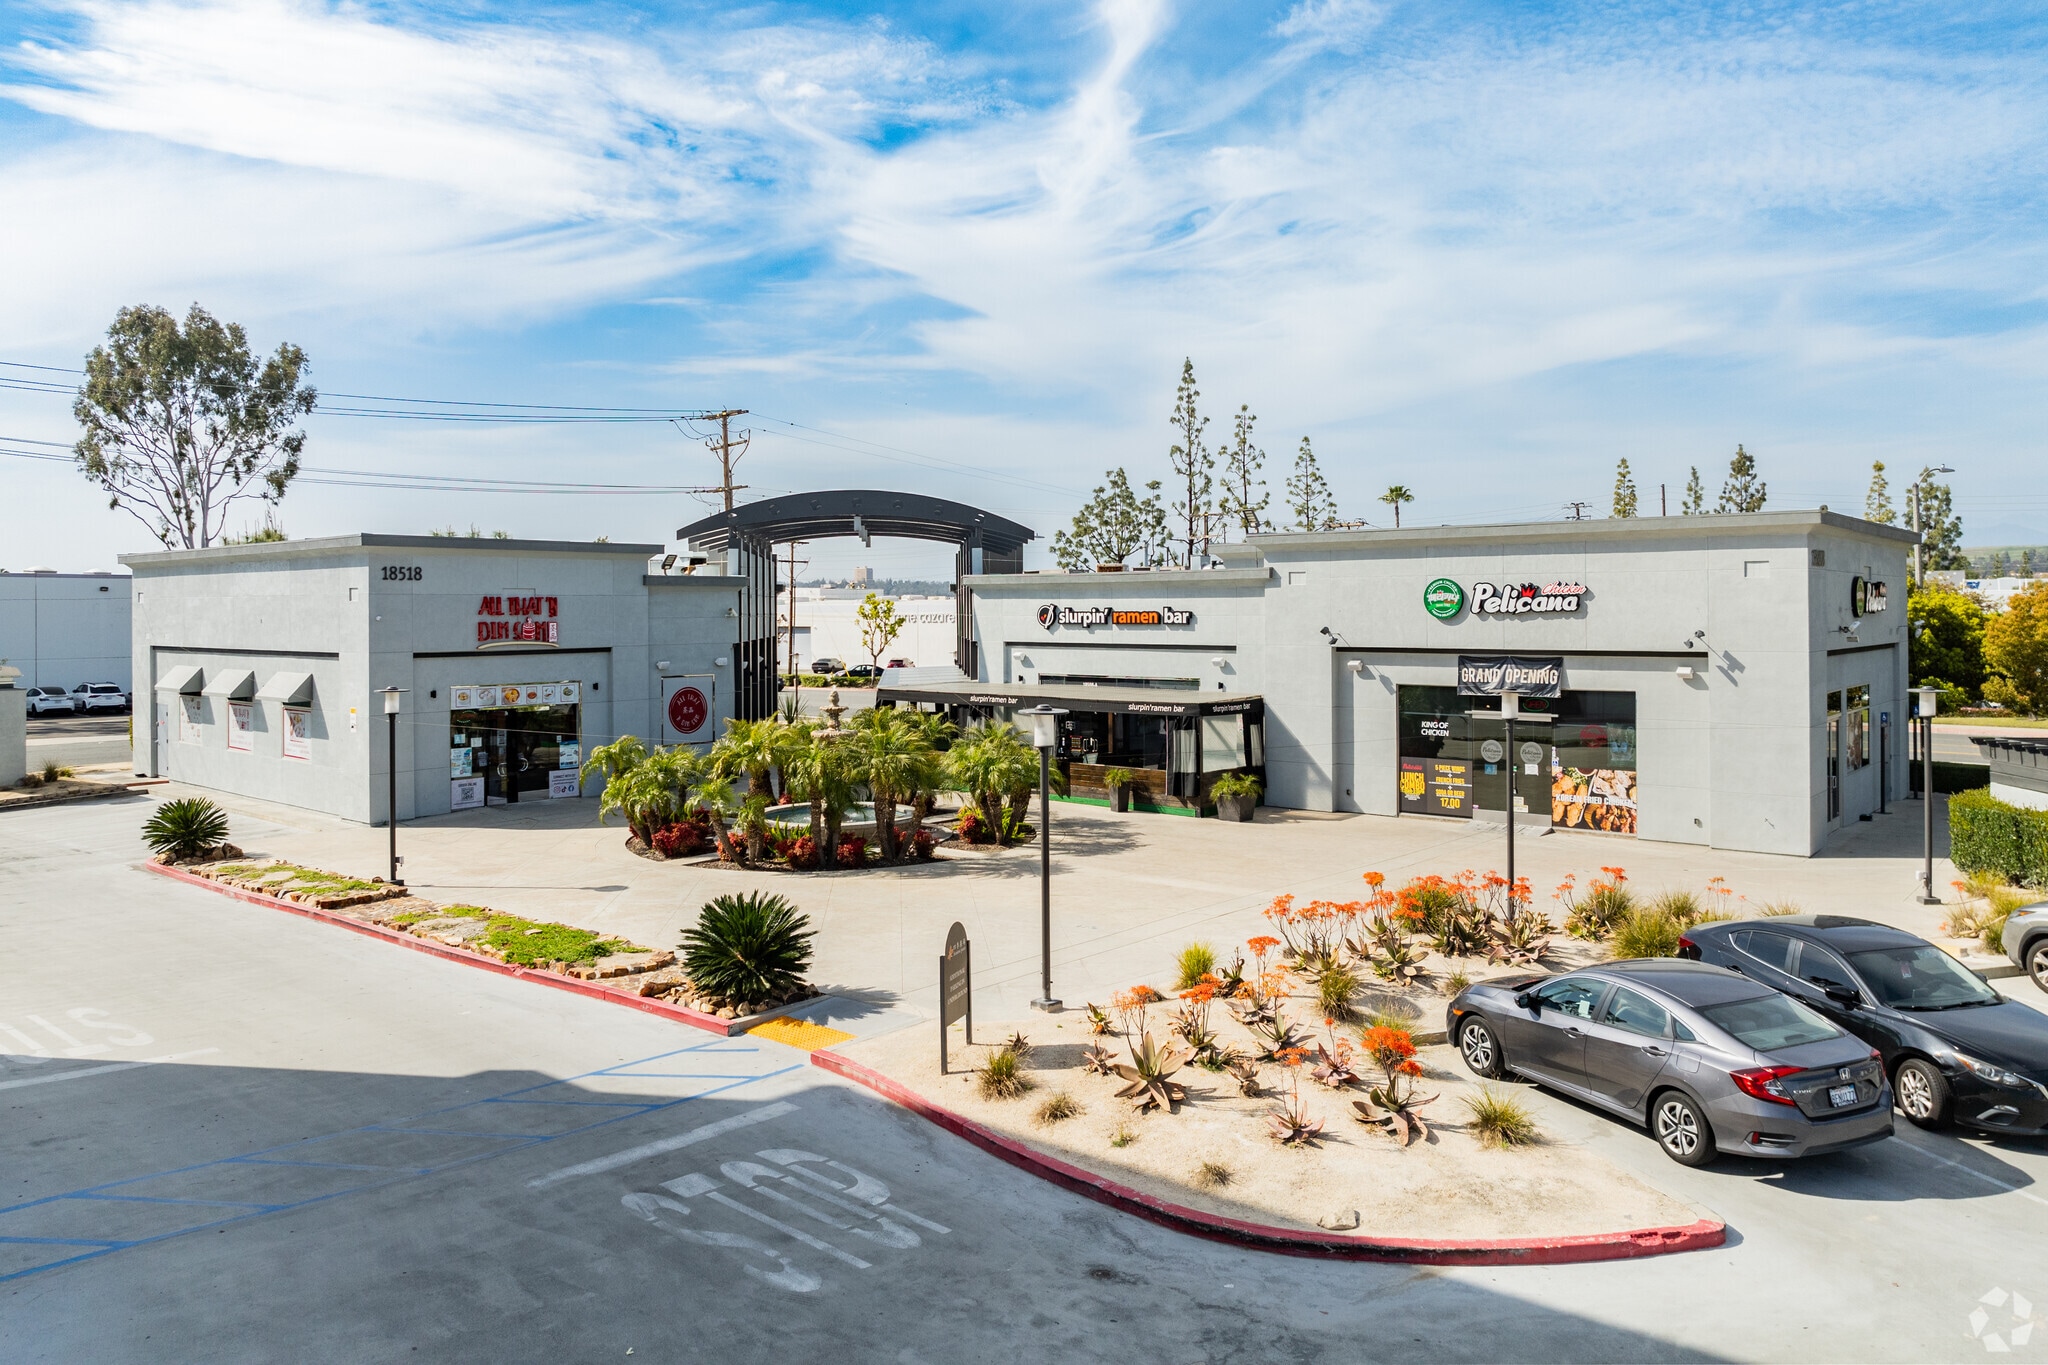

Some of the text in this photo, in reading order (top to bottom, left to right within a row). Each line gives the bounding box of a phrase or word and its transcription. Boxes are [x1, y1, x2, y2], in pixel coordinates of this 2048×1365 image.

[381, 566, 422, 581] 18518
[1541, 580, 1587, 596] Chicken
[478, 596, 504, 616] ALL
[1471, 582, 1579, 615] Pelicana
[1058, 607, 1190, 628] slurpin' ramen bar
[477, 621, 509, 642] DIM
[1461, 667, 1558, 685] GRAND OPENING
[1173, 704, 1185, 713] bar
[1421, 721, 1438, 729] KING
[1421, 729, 1449, 737] CHICKEN
[1400, 771, 1424, 781] LUNCH
[1556, 793, 1582, 803] KOREAN
[1584, 796, 1602, 805] FRIED
[620, 1148, 953, 1293] STOP
